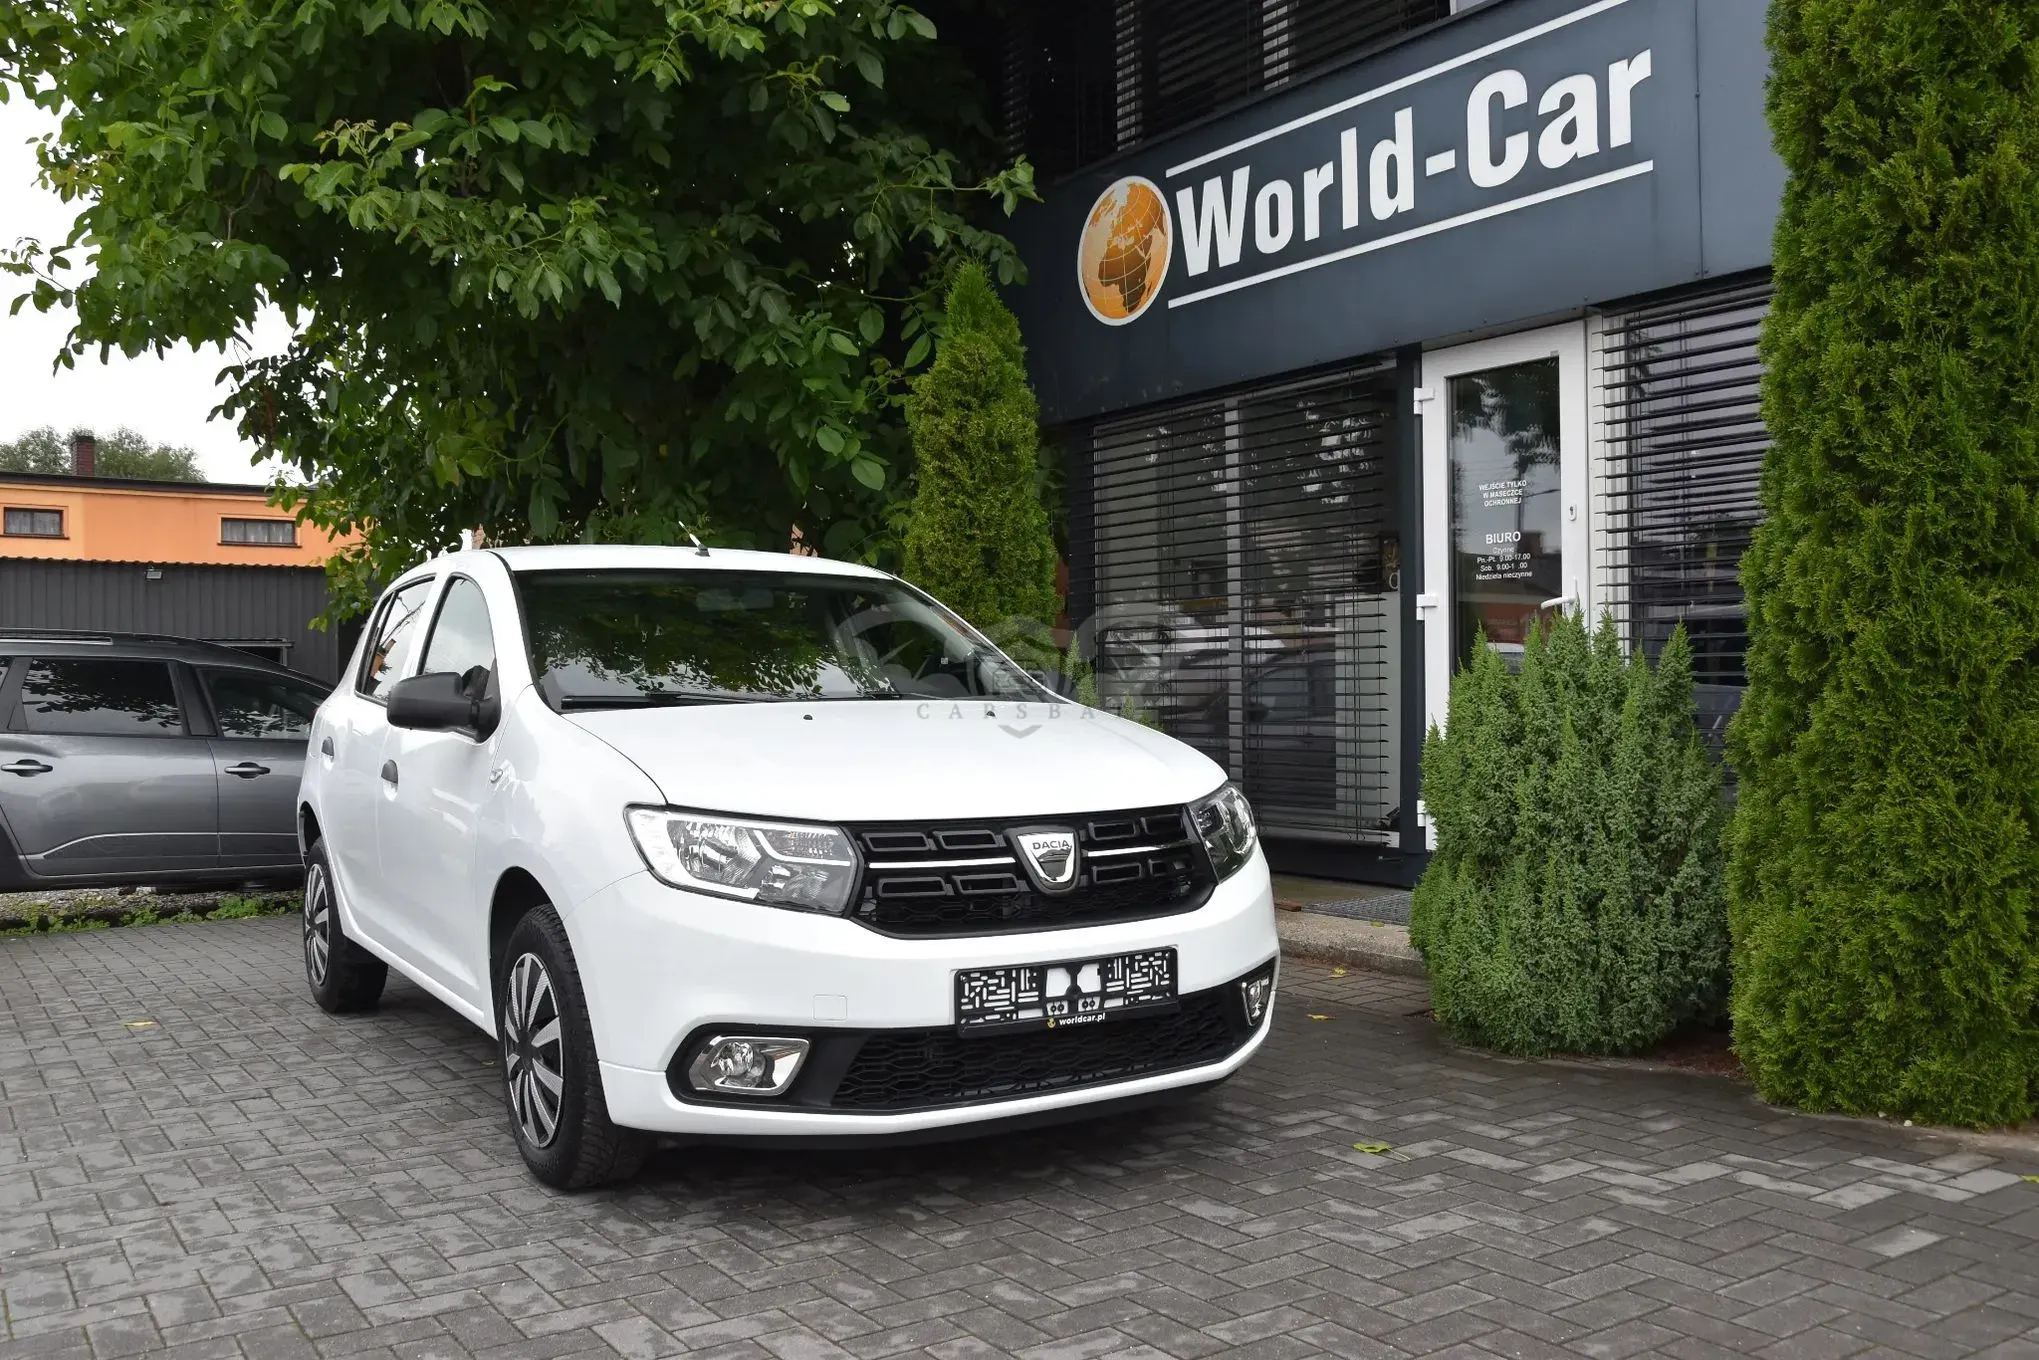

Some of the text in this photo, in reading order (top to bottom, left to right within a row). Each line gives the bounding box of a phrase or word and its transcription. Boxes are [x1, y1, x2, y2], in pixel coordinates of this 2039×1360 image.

[1175, 48, 1652, 277] World-Car
[1507, 480, 1527, 488] TYLKO
[1490, 489, 1523, 498] MASECZCE
[1483, 497, 1522, 507] OCHRONNEJ
[1485, 531, 1521, 544] BIURO
[1503, 571, 1533, 579] nieczynne
[1032, 840, 1070, 850] DACIA
[1059, 1013, 1106, 1026] worldcar.pl
